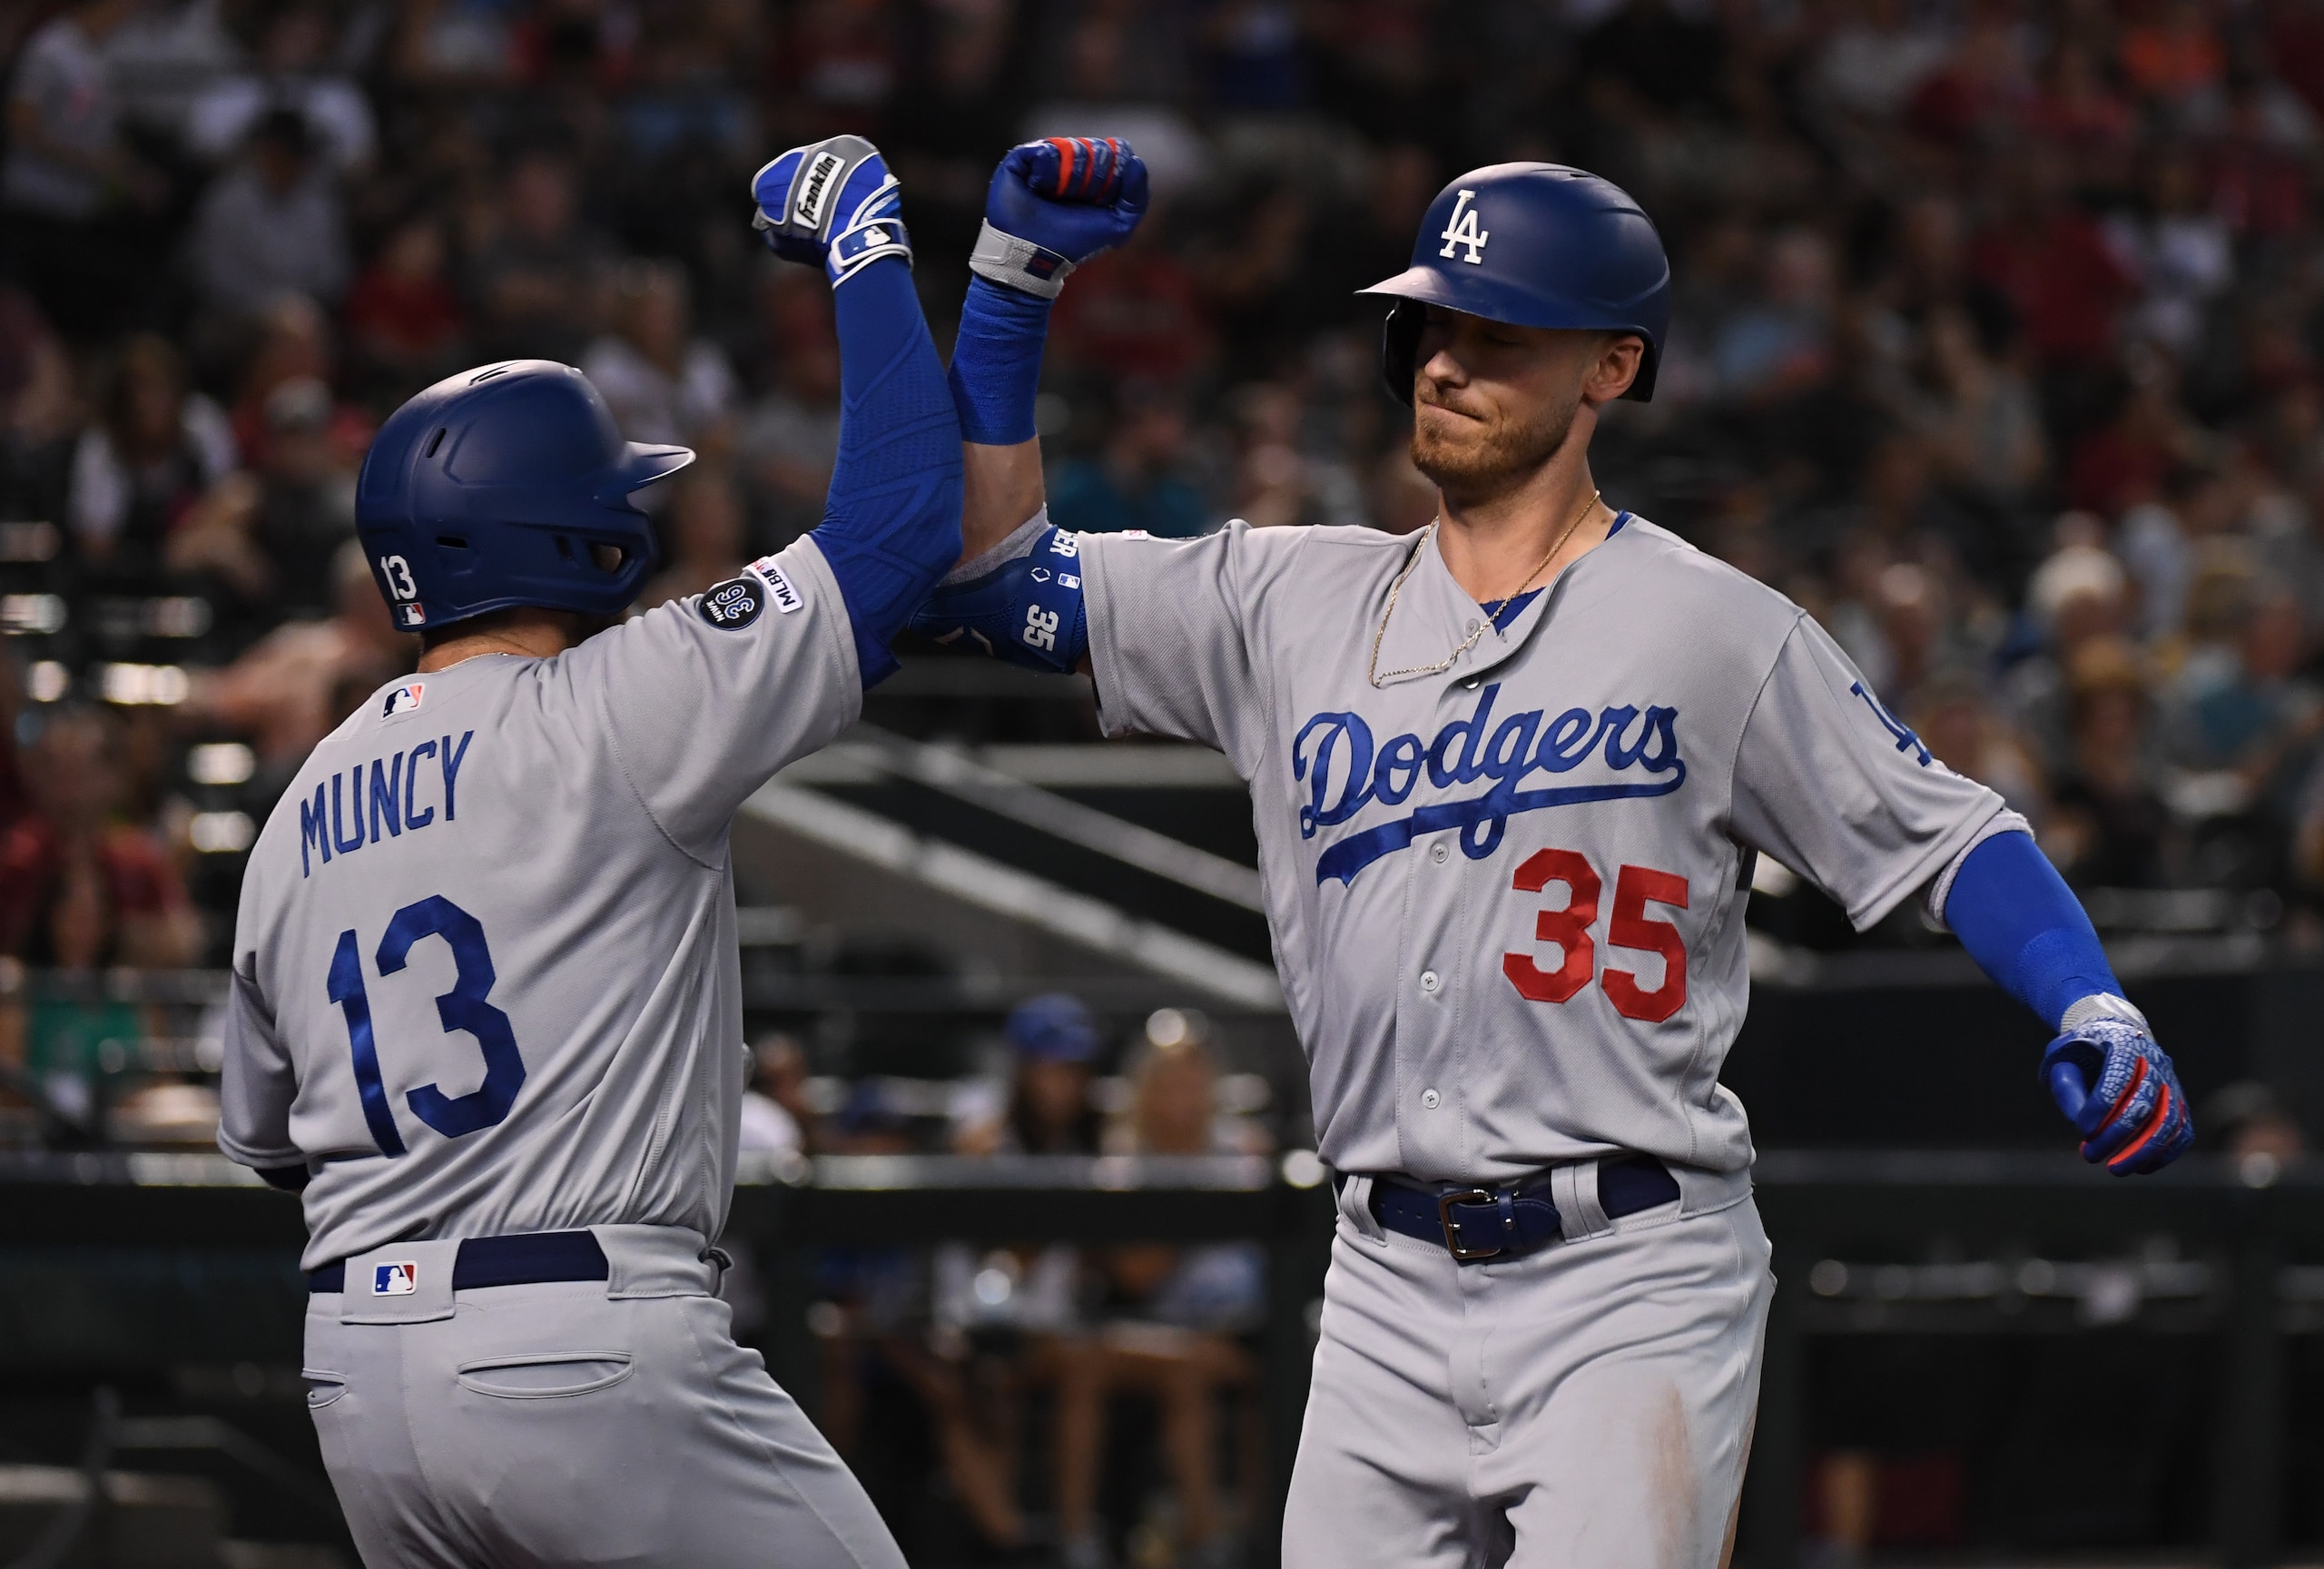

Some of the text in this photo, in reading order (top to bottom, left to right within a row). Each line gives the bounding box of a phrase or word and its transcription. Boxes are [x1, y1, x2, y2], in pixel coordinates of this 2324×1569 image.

[1439, 189, 1489, 264] LA
[380, 555, 418, 600] 13
[715, 585, 755, 619] 36
[768, 575, 796, 607] MLB
[705, 600, 725, 622] NEWK
[1023, 604, 1059, 652] 35
[1293, 683, 1686, 860] Dodgers
[300, 730, 474, 879] MUNCY
[1503, 847, 1689, 1022] 35
[327, 894, 527, 1159] 13
